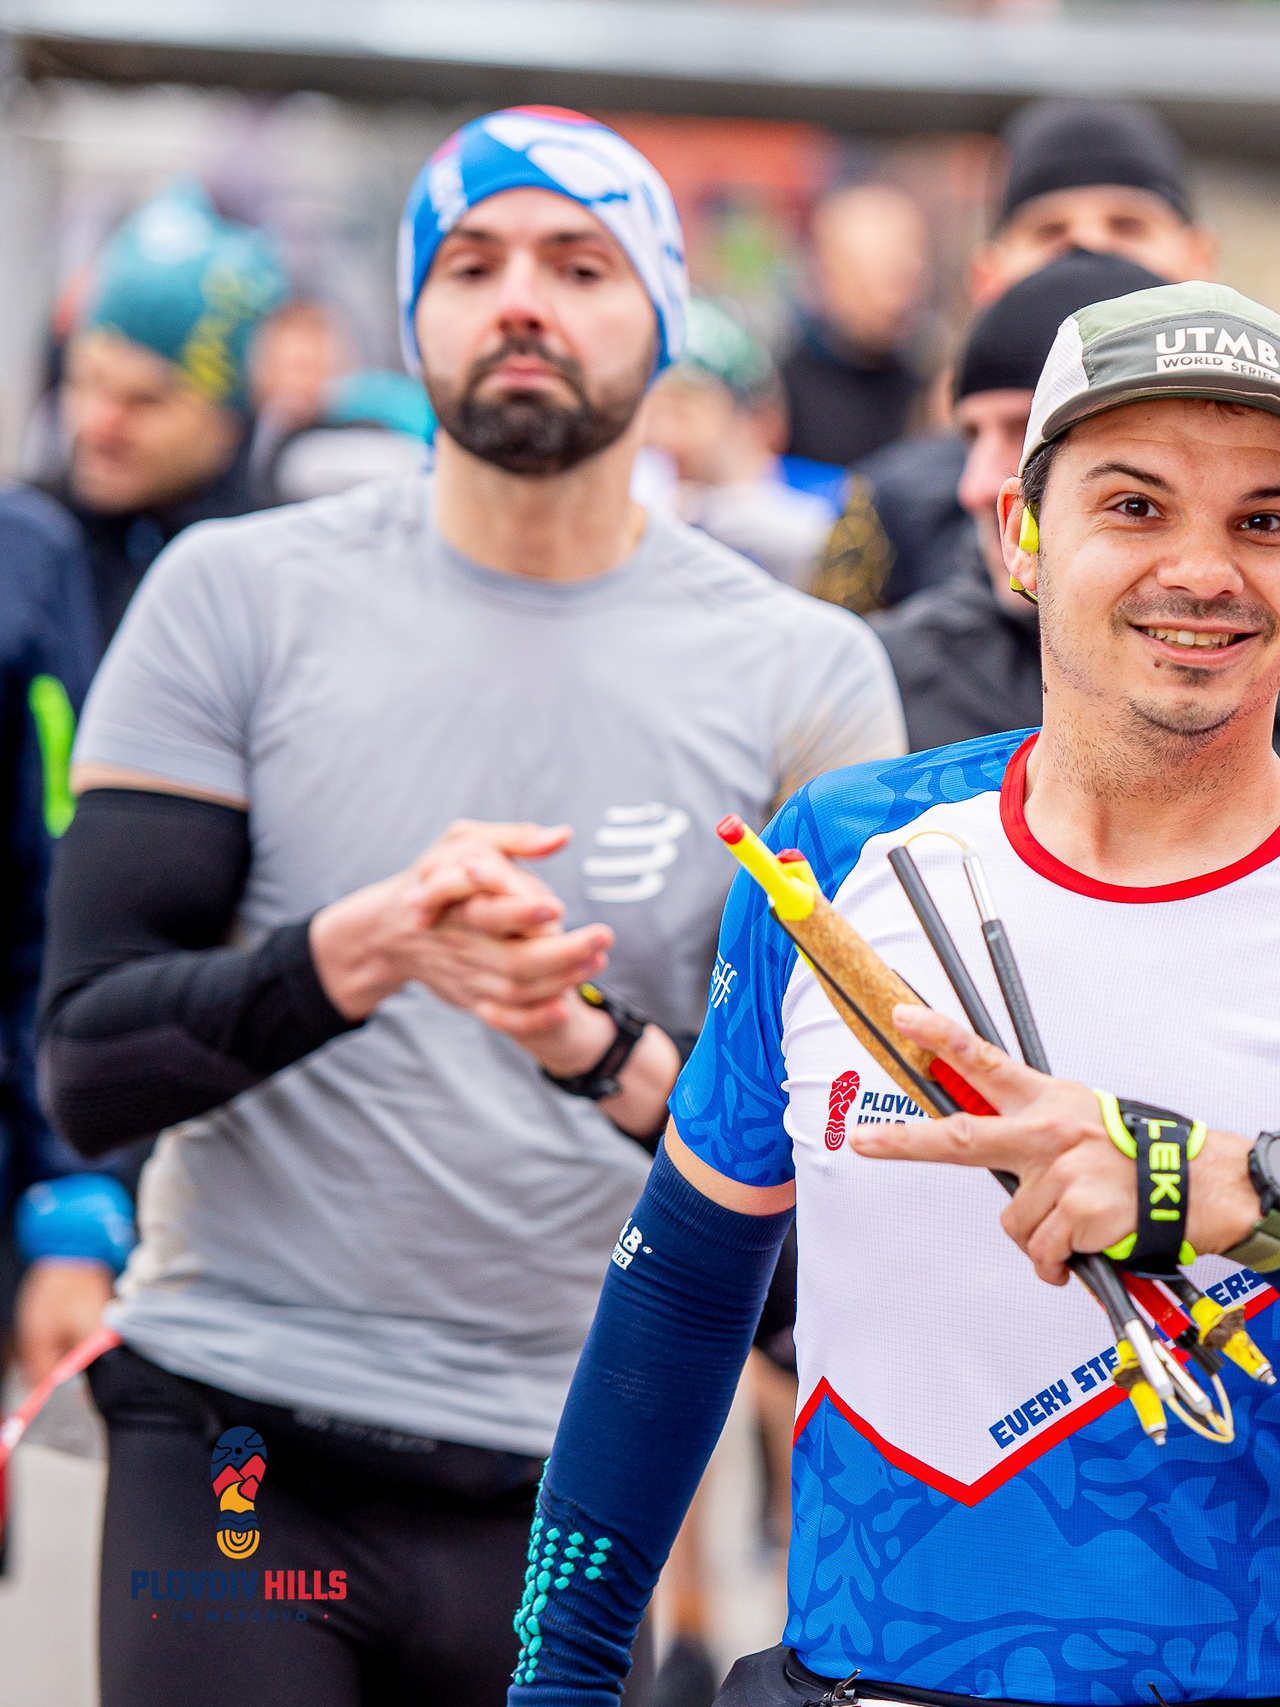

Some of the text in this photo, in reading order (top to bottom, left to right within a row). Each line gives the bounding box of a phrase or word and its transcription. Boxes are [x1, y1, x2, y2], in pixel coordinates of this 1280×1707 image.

[1156, 327, 1280, 369] UTMB
[1163, 356, 1223, 369] WORLD
[1148, 1119, 1181, 1221] LEKI
[988, 1379, 1072, 1449] EVERY
[1071, 1346, 1120, 1393] STE
